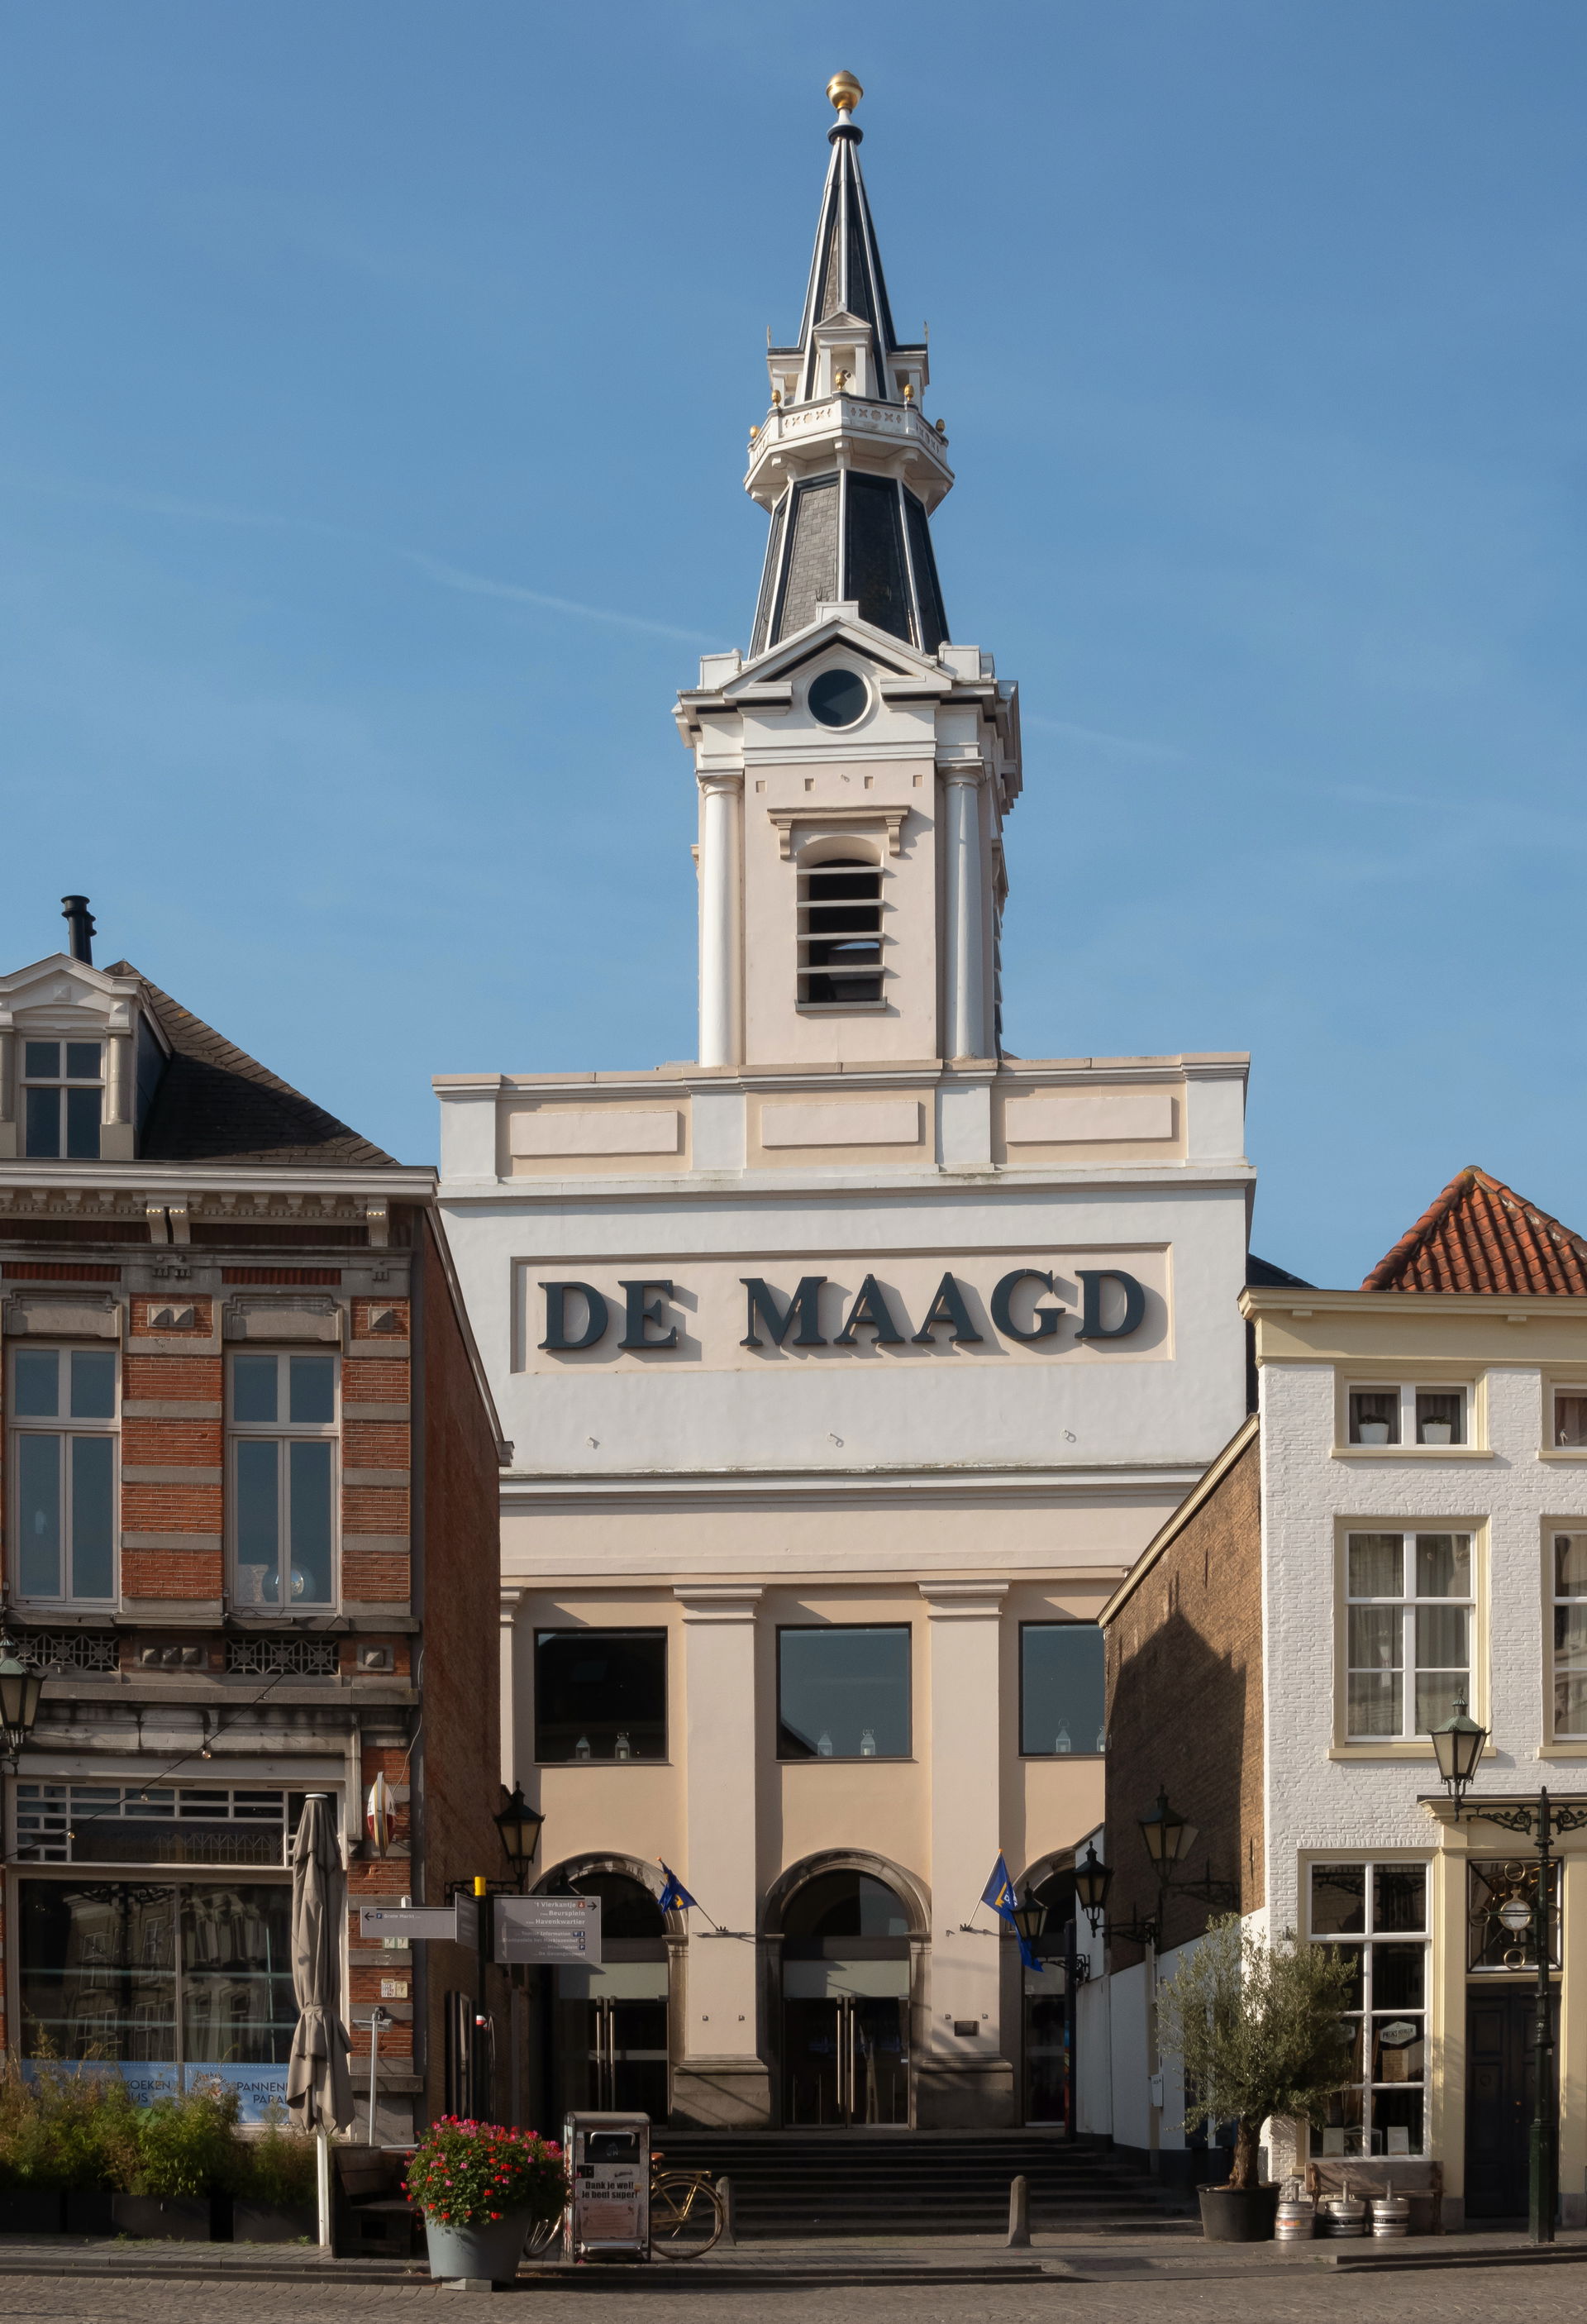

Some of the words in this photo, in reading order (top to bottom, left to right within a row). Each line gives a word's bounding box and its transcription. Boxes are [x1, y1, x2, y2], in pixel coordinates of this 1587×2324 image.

[537, 1279, 679, 1351] DE
[739, 1268, 1147, 1348] MAAGD
[236, 2081, 288, 2092] PANNEN
[253, 2094, 288, 2104] PARA
[585, 2181, 606, 2189] Dank
[607, 2181, 615, 2190] je
[612, 2191, 638, 2199] super!
